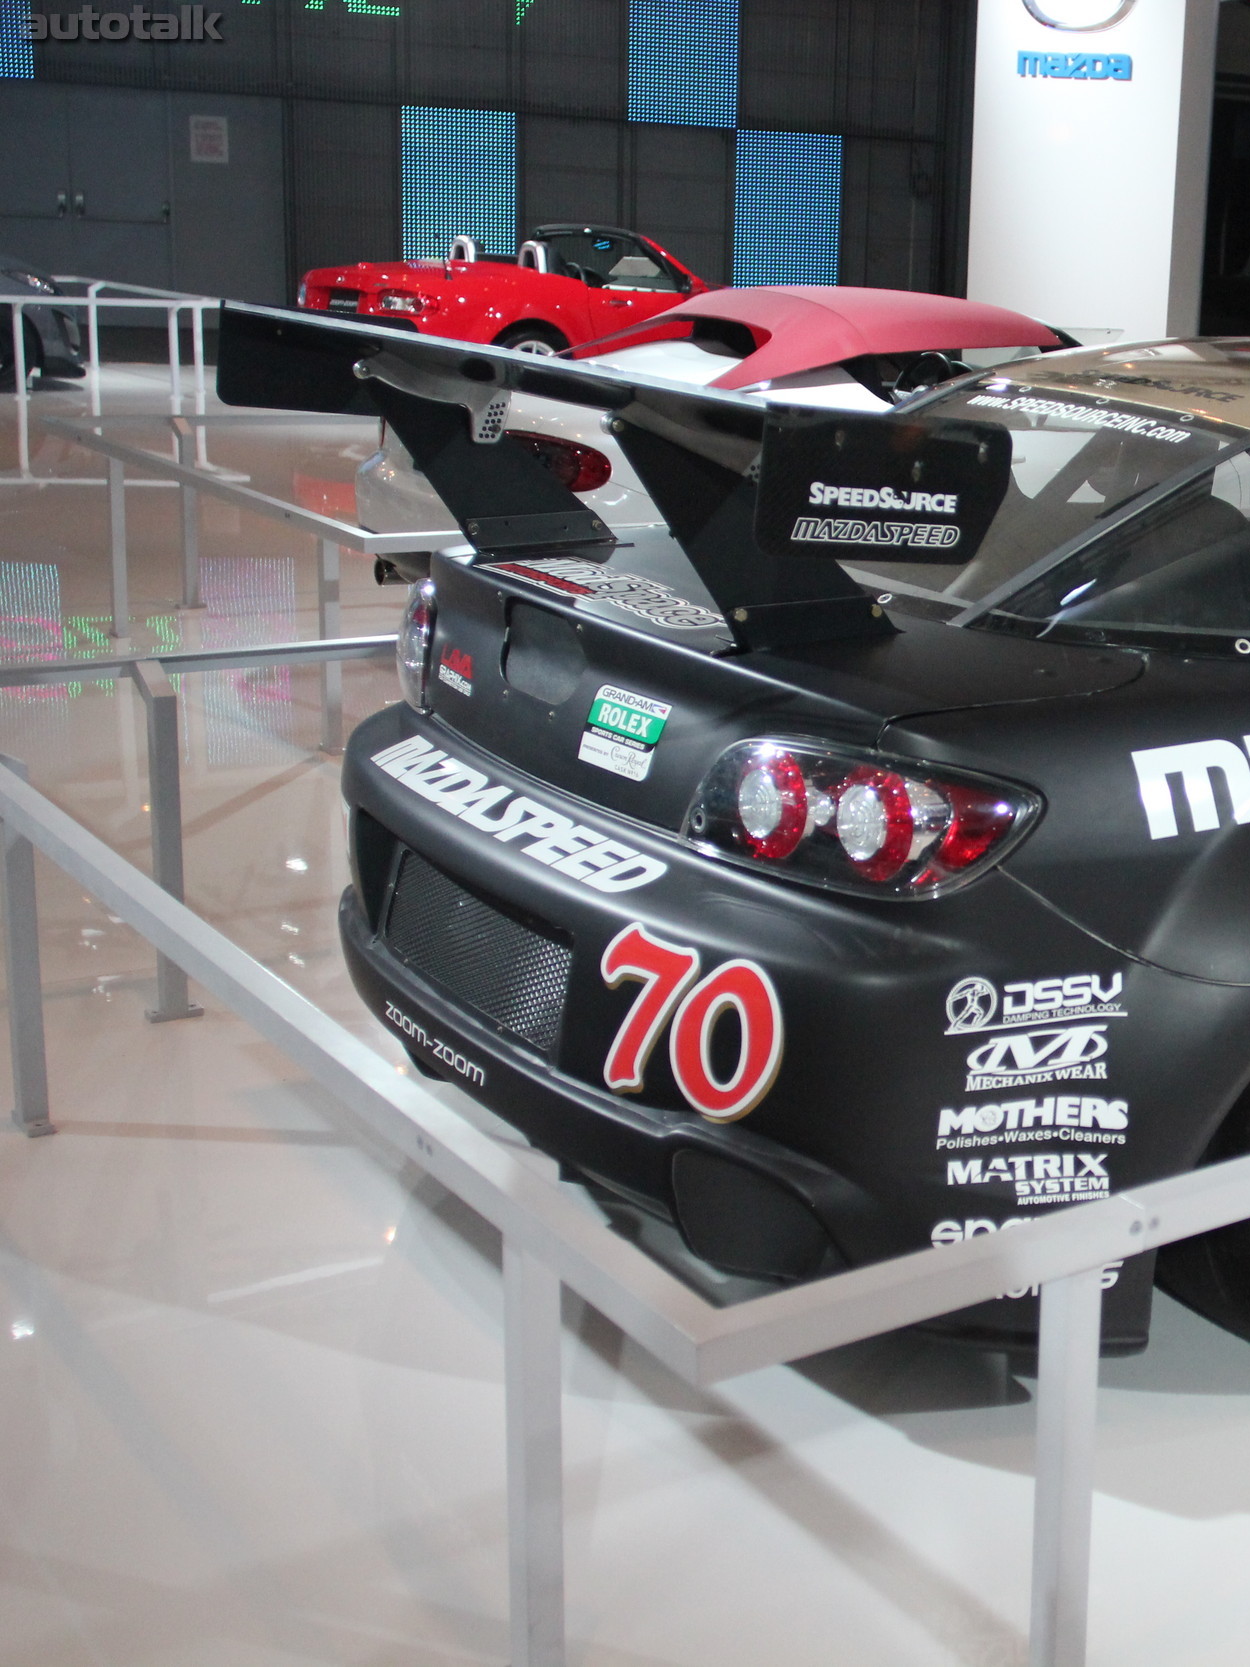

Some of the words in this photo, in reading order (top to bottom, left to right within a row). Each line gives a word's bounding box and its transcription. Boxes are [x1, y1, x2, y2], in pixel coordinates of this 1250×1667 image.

[1017, 50, 1132, 81] mazda
[966, 392, 1191, 444] www.SPEEDSOURCEINC.com
[791, 517, 960, 547] MAZDASPEED
[597, 702, 653, 738] ROLEX
[370, 734, 667, 893] MAZDASPEED
[1003, 972, 1122, 1015] DSSV
[600, 921, 783, 1123] 70
[1002, 1011, 1049, 1025] DAMPING
[1052, 1003, 1122, 1017] TECHNOLOGY
[384, 1000, 485, 1087] zoom-zoom
[965, 1069, 1053, 1092] MECHANIX
[1055, 1062, 1108, 1081] WEAR
[938, 1096, 1129, 1136] MOTHERS
[947, 1153, 1109, 1185] MATRIX
[1015, 1177, 1109, 1196] SYSTEM
[1017, 1193, 1070, 1206] AUTOMOTIVE
[1072, 1190, 1109, 1201] FINISHES
